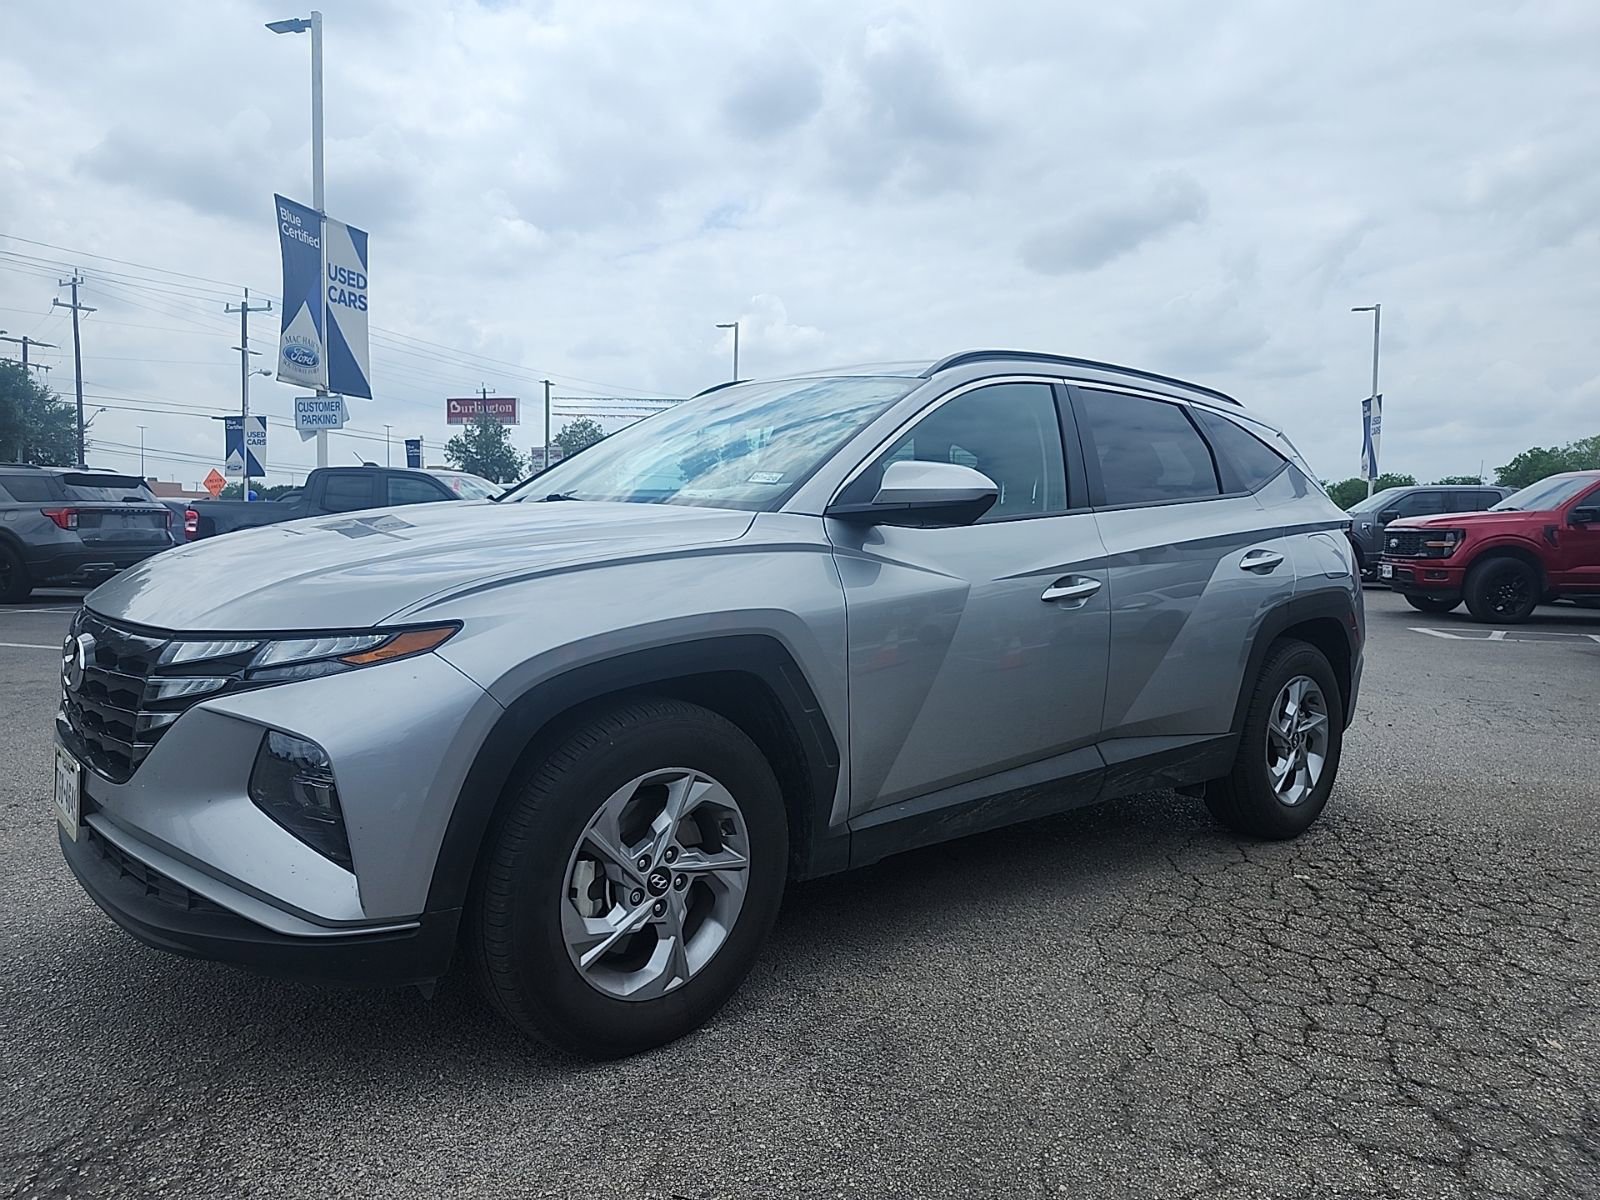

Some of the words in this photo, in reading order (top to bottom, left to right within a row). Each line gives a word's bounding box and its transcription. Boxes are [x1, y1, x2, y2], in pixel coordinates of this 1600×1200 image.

[280, 206, 301, 226] Blue
[281, 222, 320, 249] Certified
[328, 262, 368, 290] USED
[328, 285, 368, 312] CARS
[290, 346, 315, 365] Ford
[297, 401, 340, 413] CUSTOMER
[450, 400, 513, 415] Burlington
[301, 414, 337, 425] PARKING
[247, 438, 266, 446] CARS
